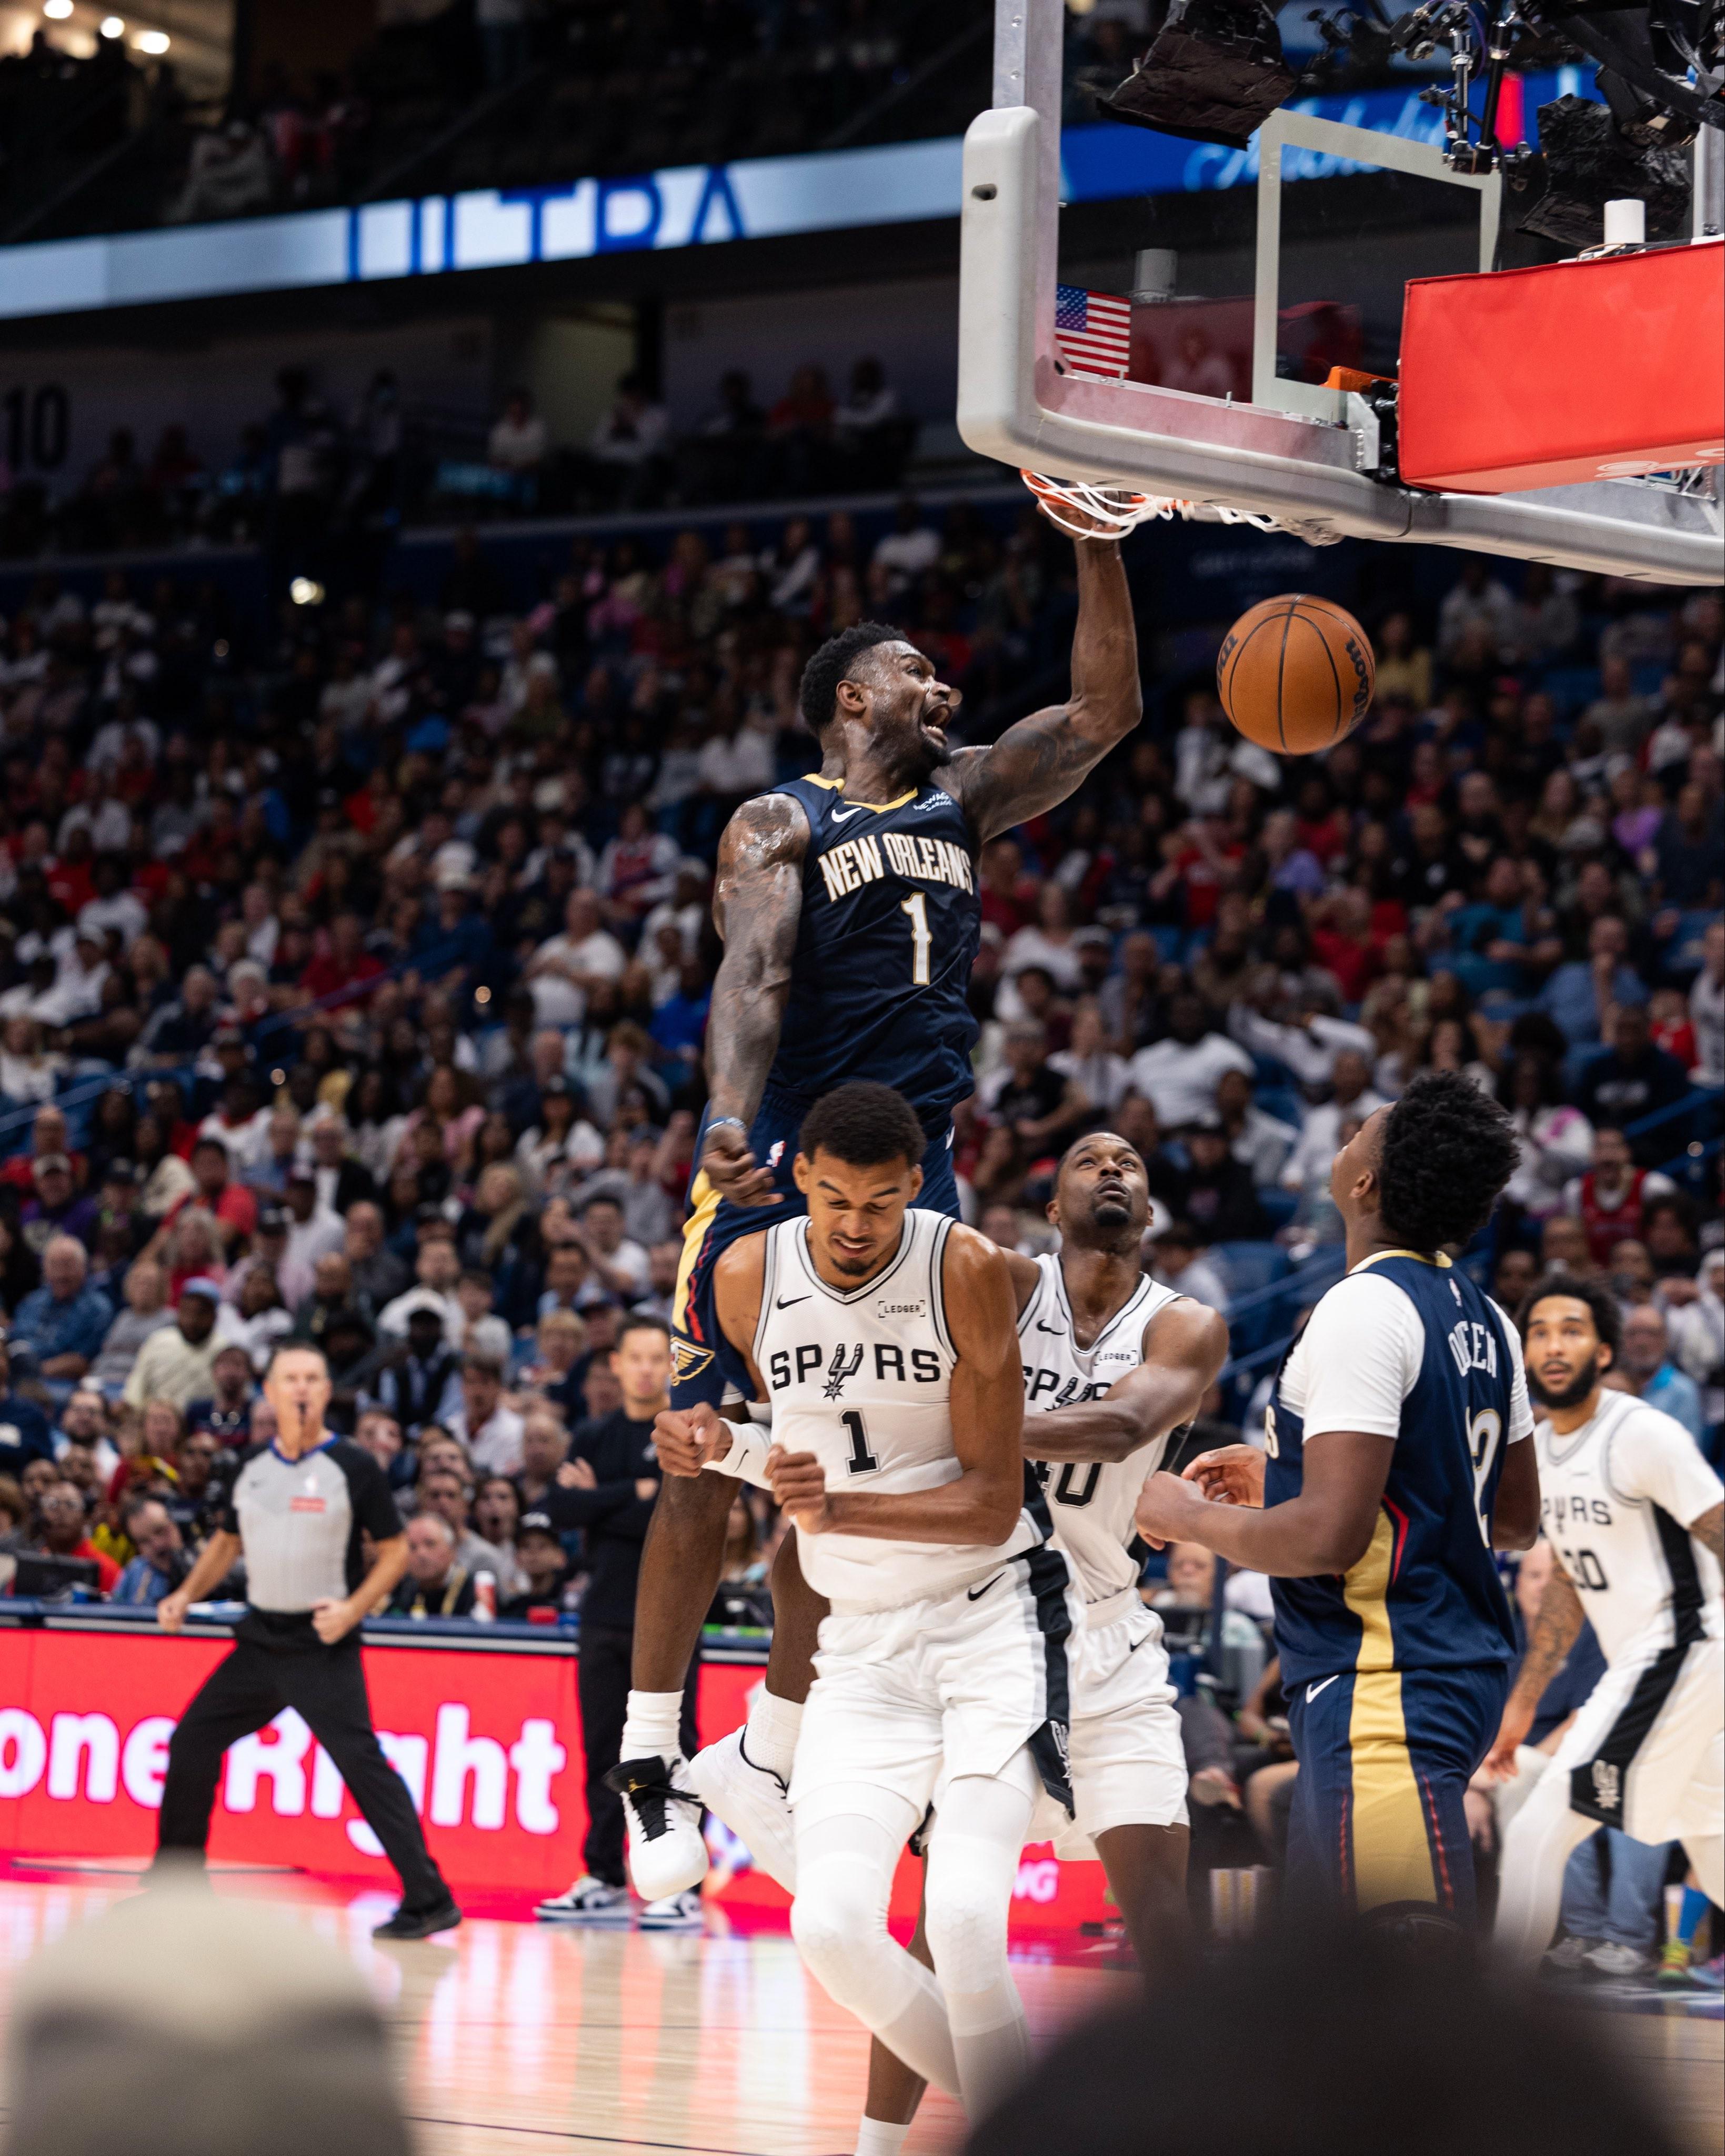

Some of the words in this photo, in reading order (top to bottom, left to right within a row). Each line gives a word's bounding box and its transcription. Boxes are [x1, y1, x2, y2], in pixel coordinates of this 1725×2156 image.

[817, 834, 884, 903] NEW
[882, 832, 974, 896] ORLEANS
[900, 892, 932, 985] 1
[885, 1305, 920, 1313] LEDGER
[770, 1343, 941, 1402] SPURS
[838, 1408, 881, 1477] 1
[1466, 1406, 1501, 1549] 2
[1541, 1496, 1612, 1534] PURS
